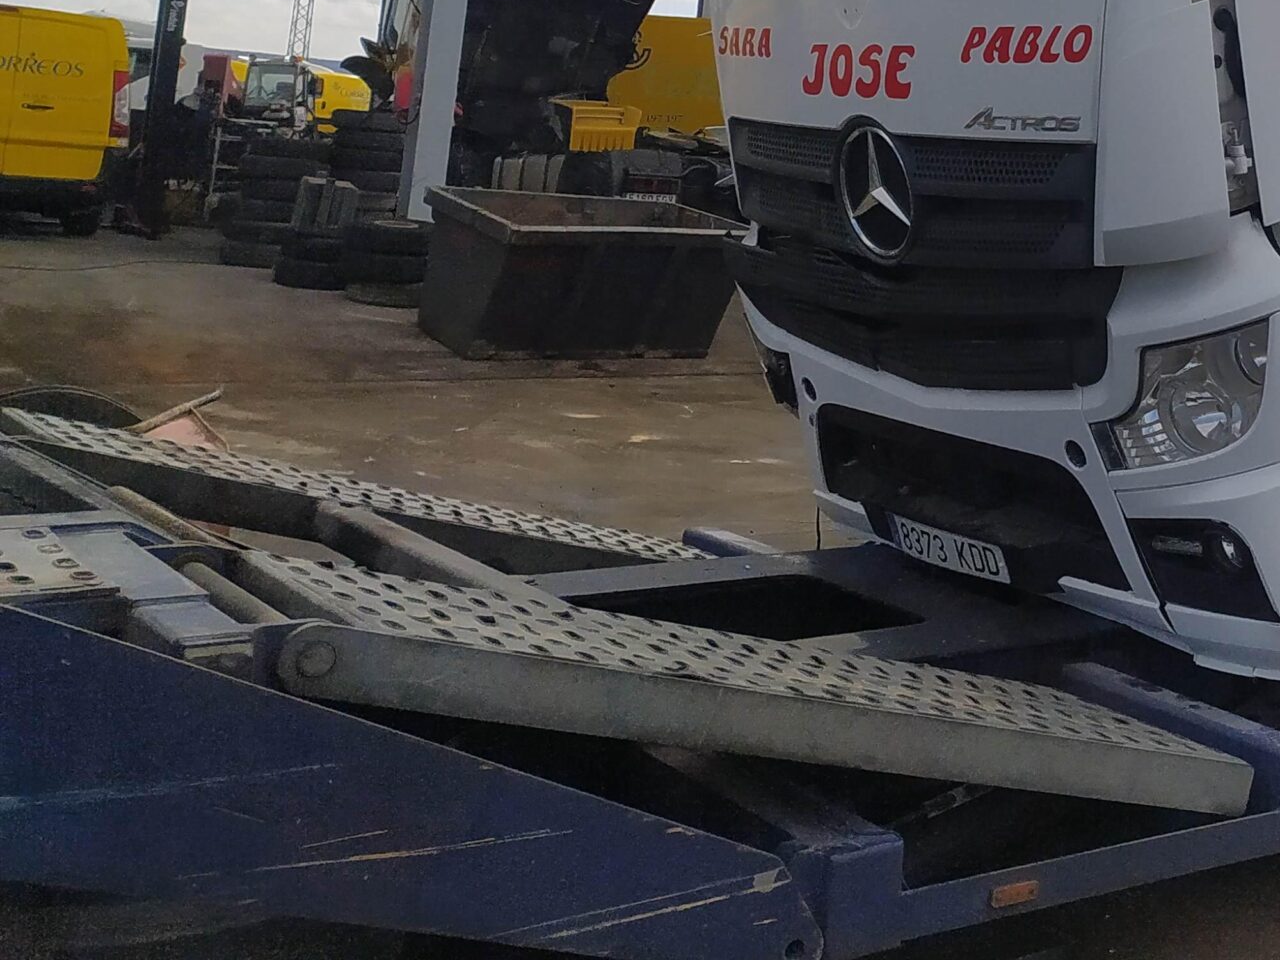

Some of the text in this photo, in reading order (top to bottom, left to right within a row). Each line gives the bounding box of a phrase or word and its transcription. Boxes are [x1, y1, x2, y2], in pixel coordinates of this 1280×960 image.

[719, 25, 772, 58] SARA
[961, 24, 1093, 64] PABLO
[802, 44, 915, 99] JOSE
[900, 522, 999, 576] 8373 KDD
